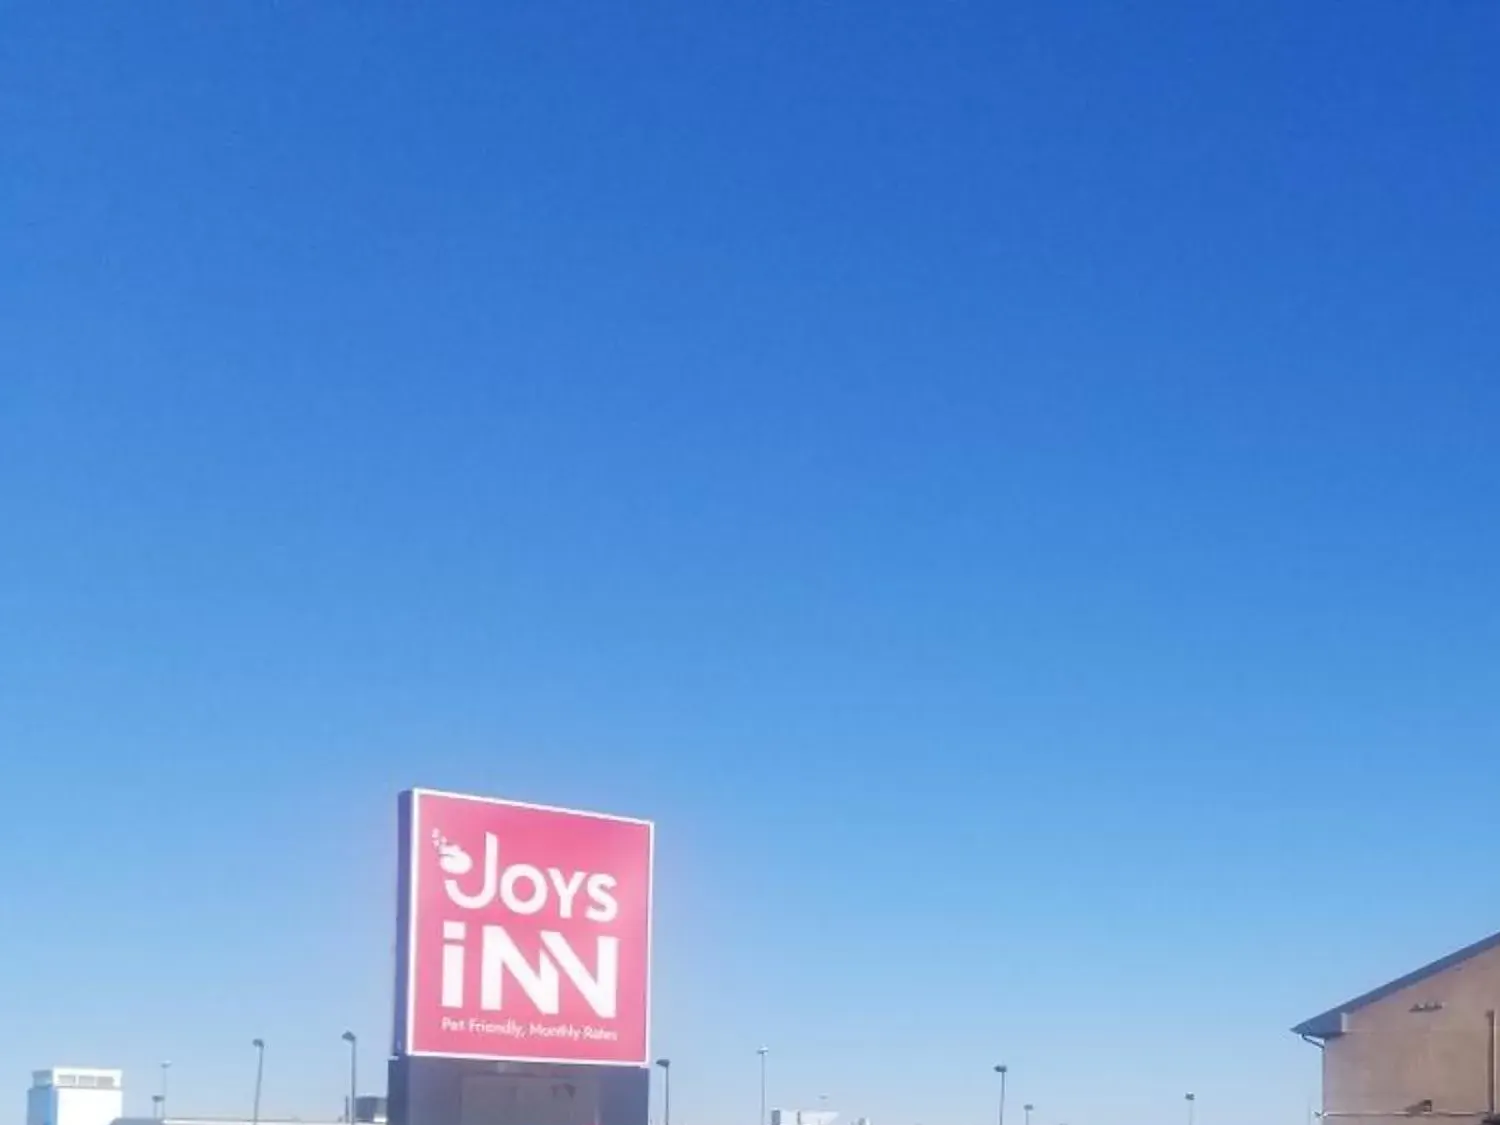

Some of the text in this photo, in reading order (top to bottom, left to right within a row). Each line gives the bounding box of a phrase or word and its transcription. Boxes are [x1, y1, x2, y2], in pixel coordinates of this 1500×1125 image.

[444, 831, 618, 922] JOYS
[441, 1016, 465, 1031] Pet
[529, 1023, 580, 1041] Monthly
[582, 1025, 618, 1041] Rates
